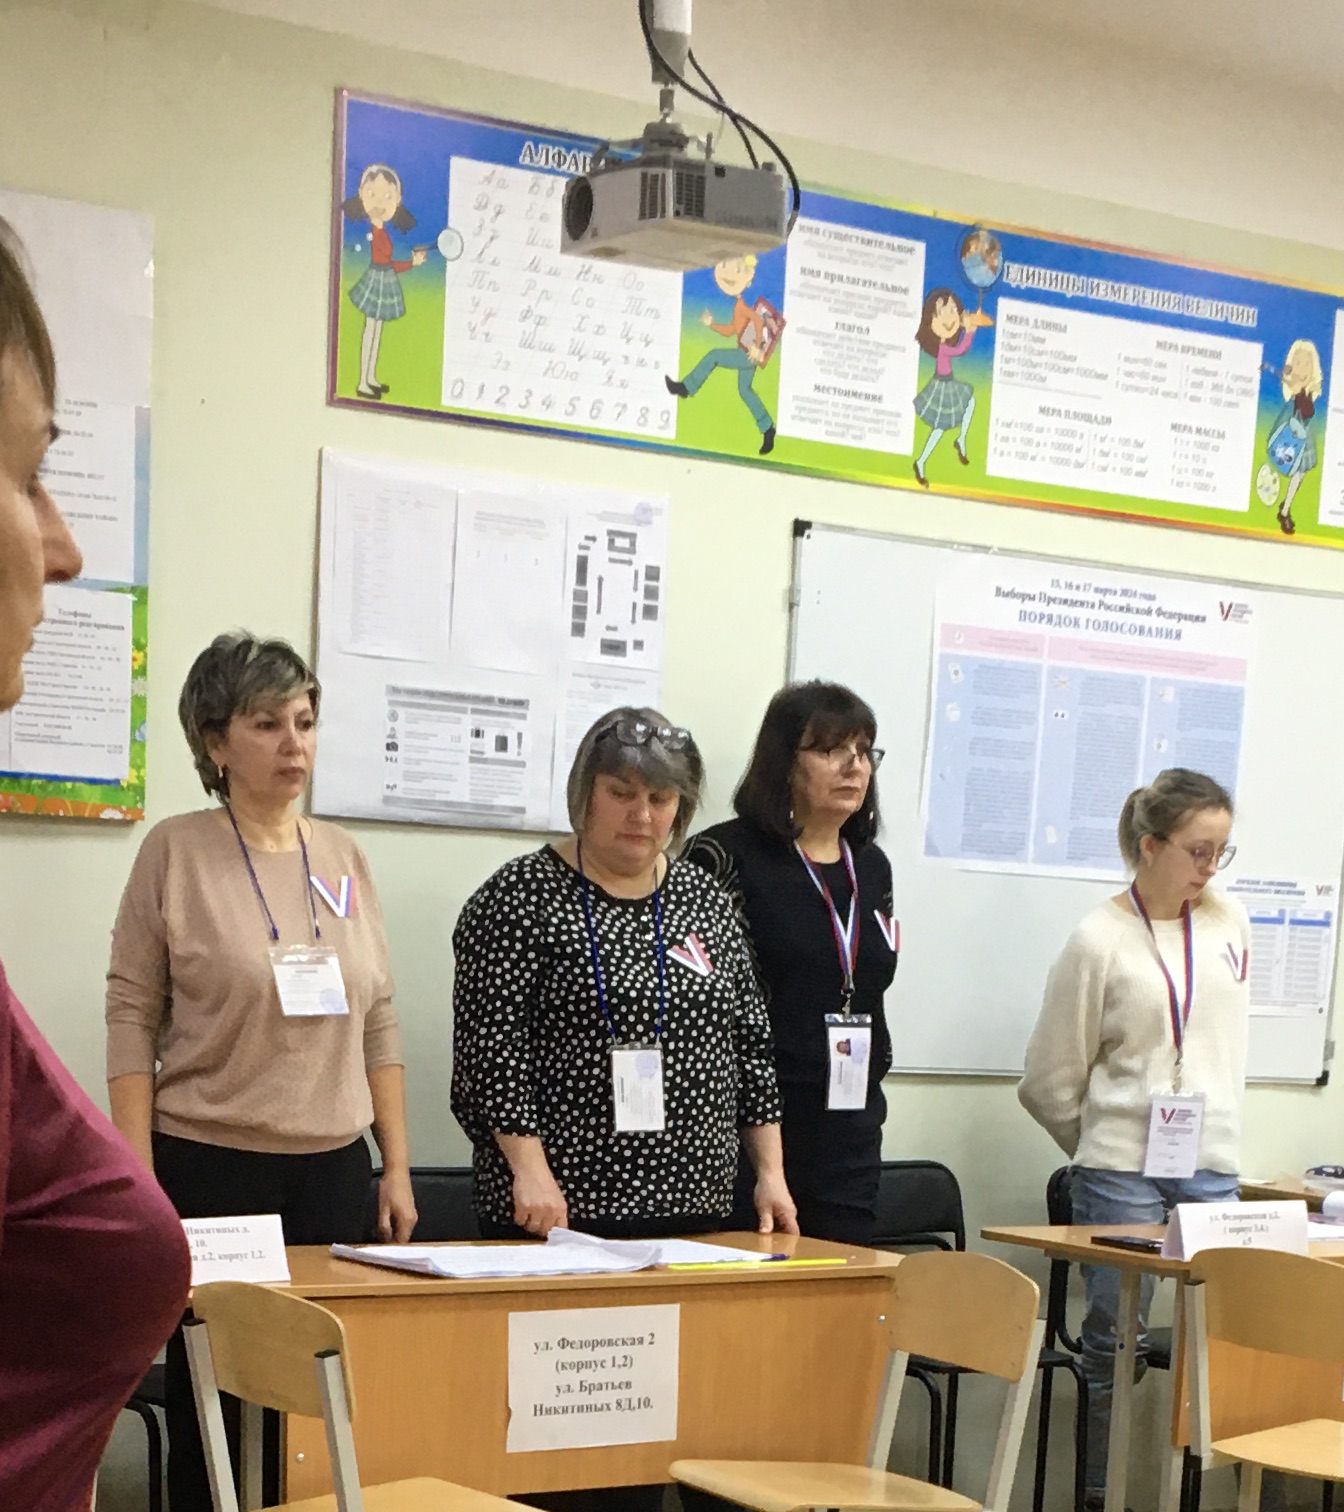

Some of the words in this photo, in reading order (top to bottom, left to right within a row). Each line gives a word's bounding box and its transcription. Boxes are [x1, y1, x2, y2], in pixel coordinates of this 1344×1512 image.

[799, 223, 820, 235] имя
[822, 229, 915, 256] существительное
[800, 266, 821, 278] имя
[824, 271, 909, 296] прилагательное
[1005, 263, 1086, 295] ЕДИНИЦЫ
[1088, 280, 1182, 312] ИЗМЕРЕНИЯ
[1184, 296, 1257, 327] ВЕЛИЧИН
[835, 322, 870, 335] глагол
[1006, 313, 1029, 327] МЕРА
[1031, 318, 1068, 334] ДЛИНЫ
[1156, 339, 1179, 353] МЕРА
[1180, 344, 1222, 360] ВРЕМЕНИ
[814, 384, 883, 403] местоимение
[1038, 405, 1062, 418] МЕРА
[1064, 410, 1112, 426] ПЛОЩАДИ
[1170, 422, 1193, 435] МЕРА
[1195, 426, 1226, 440] МАССЫ
[995, 586, 1036, 602] Выборы
[1039, 591, 1096, 610] Президента
[1098, 599, 1153, 617] Российской
[1155, 605, 1207, 624] Федерации
[1018, 609, 1081, 629] ПОРЯДОК
[1085, 617, 1182, 641] ГОЛОСОВАНИЯ
[534, 1341, 553, 1355] ул.
[557, 1336, 644, 1351] Федоровская
[648, 1332, 655, 1345] 2
[555, 1359, 606, 1374] (корпус
[611, 1354, 634, 1369] 1,2)
[555, 1384, 574, 1397] ул.
[578, 1380, 632, 1395] Братьев
[533, 1402, 612, 1417] Никитиных
